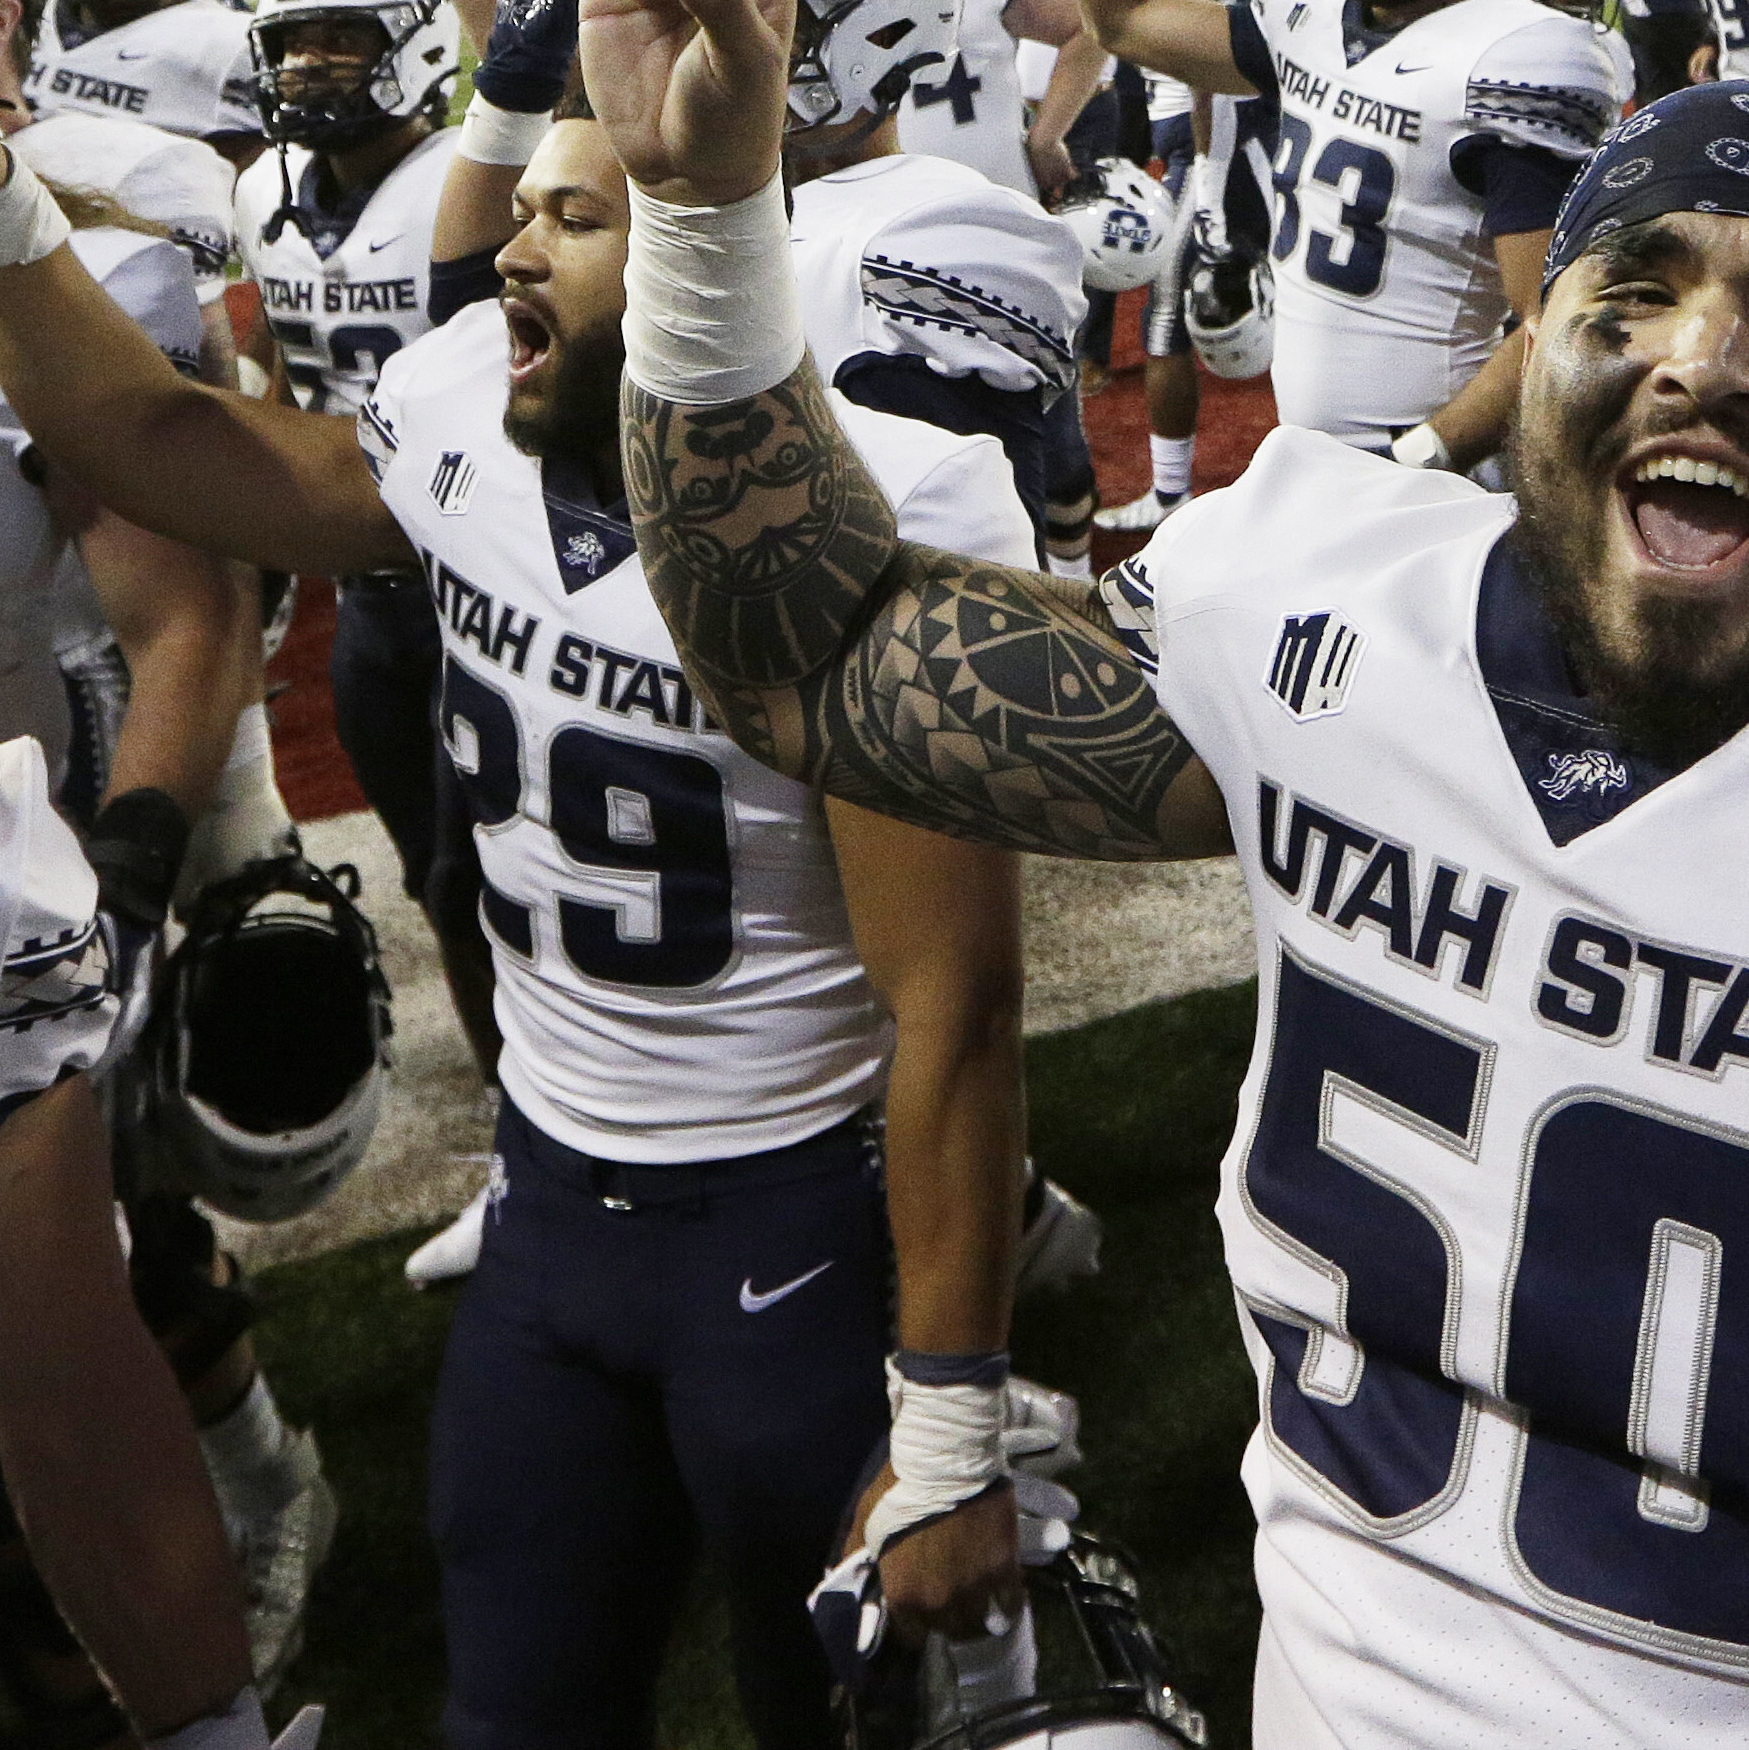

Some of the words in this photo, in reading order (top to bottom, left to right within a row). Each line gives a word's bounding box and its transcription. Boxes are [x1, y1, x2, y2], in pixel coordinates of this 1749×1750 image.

[51, 67, 150, 113] STATE
[1333, 89, 1423, 143] STATE
[325, 276, 418, 313] STATE
[550, 629, 732, 738] STAT
[439, 648, 736, 996] 29
[1256, 770, 1520, 1005] UTAH
